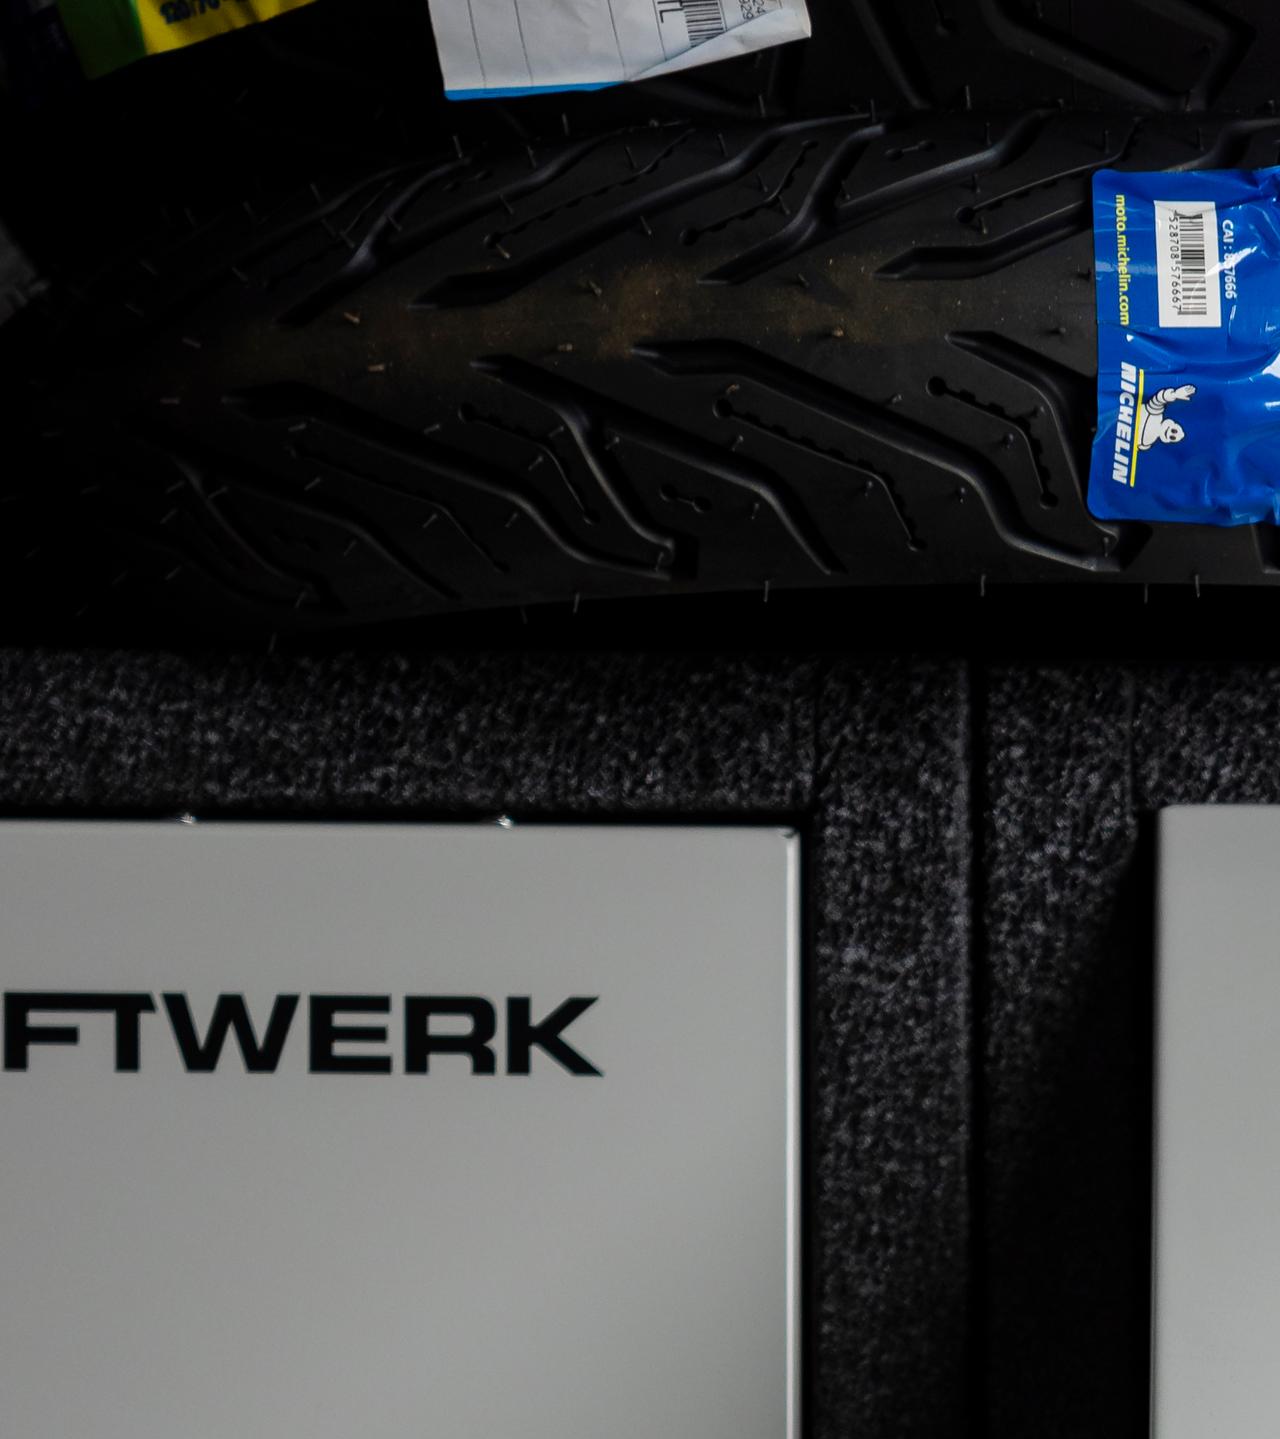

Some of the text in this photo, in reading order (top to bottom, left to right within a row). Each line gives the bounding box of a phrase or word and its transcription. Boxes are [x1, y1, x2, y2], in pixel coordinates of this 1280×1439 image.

[1115, 194, 1131, 326] moto.michelin.com
[1221, 219, 1235, 243] CAI
[1222, 252, 1237, 299] 87666
[1112, 361, 1137, 485] MICHELIN
[3, 990, 605, 1077] FTWERK
